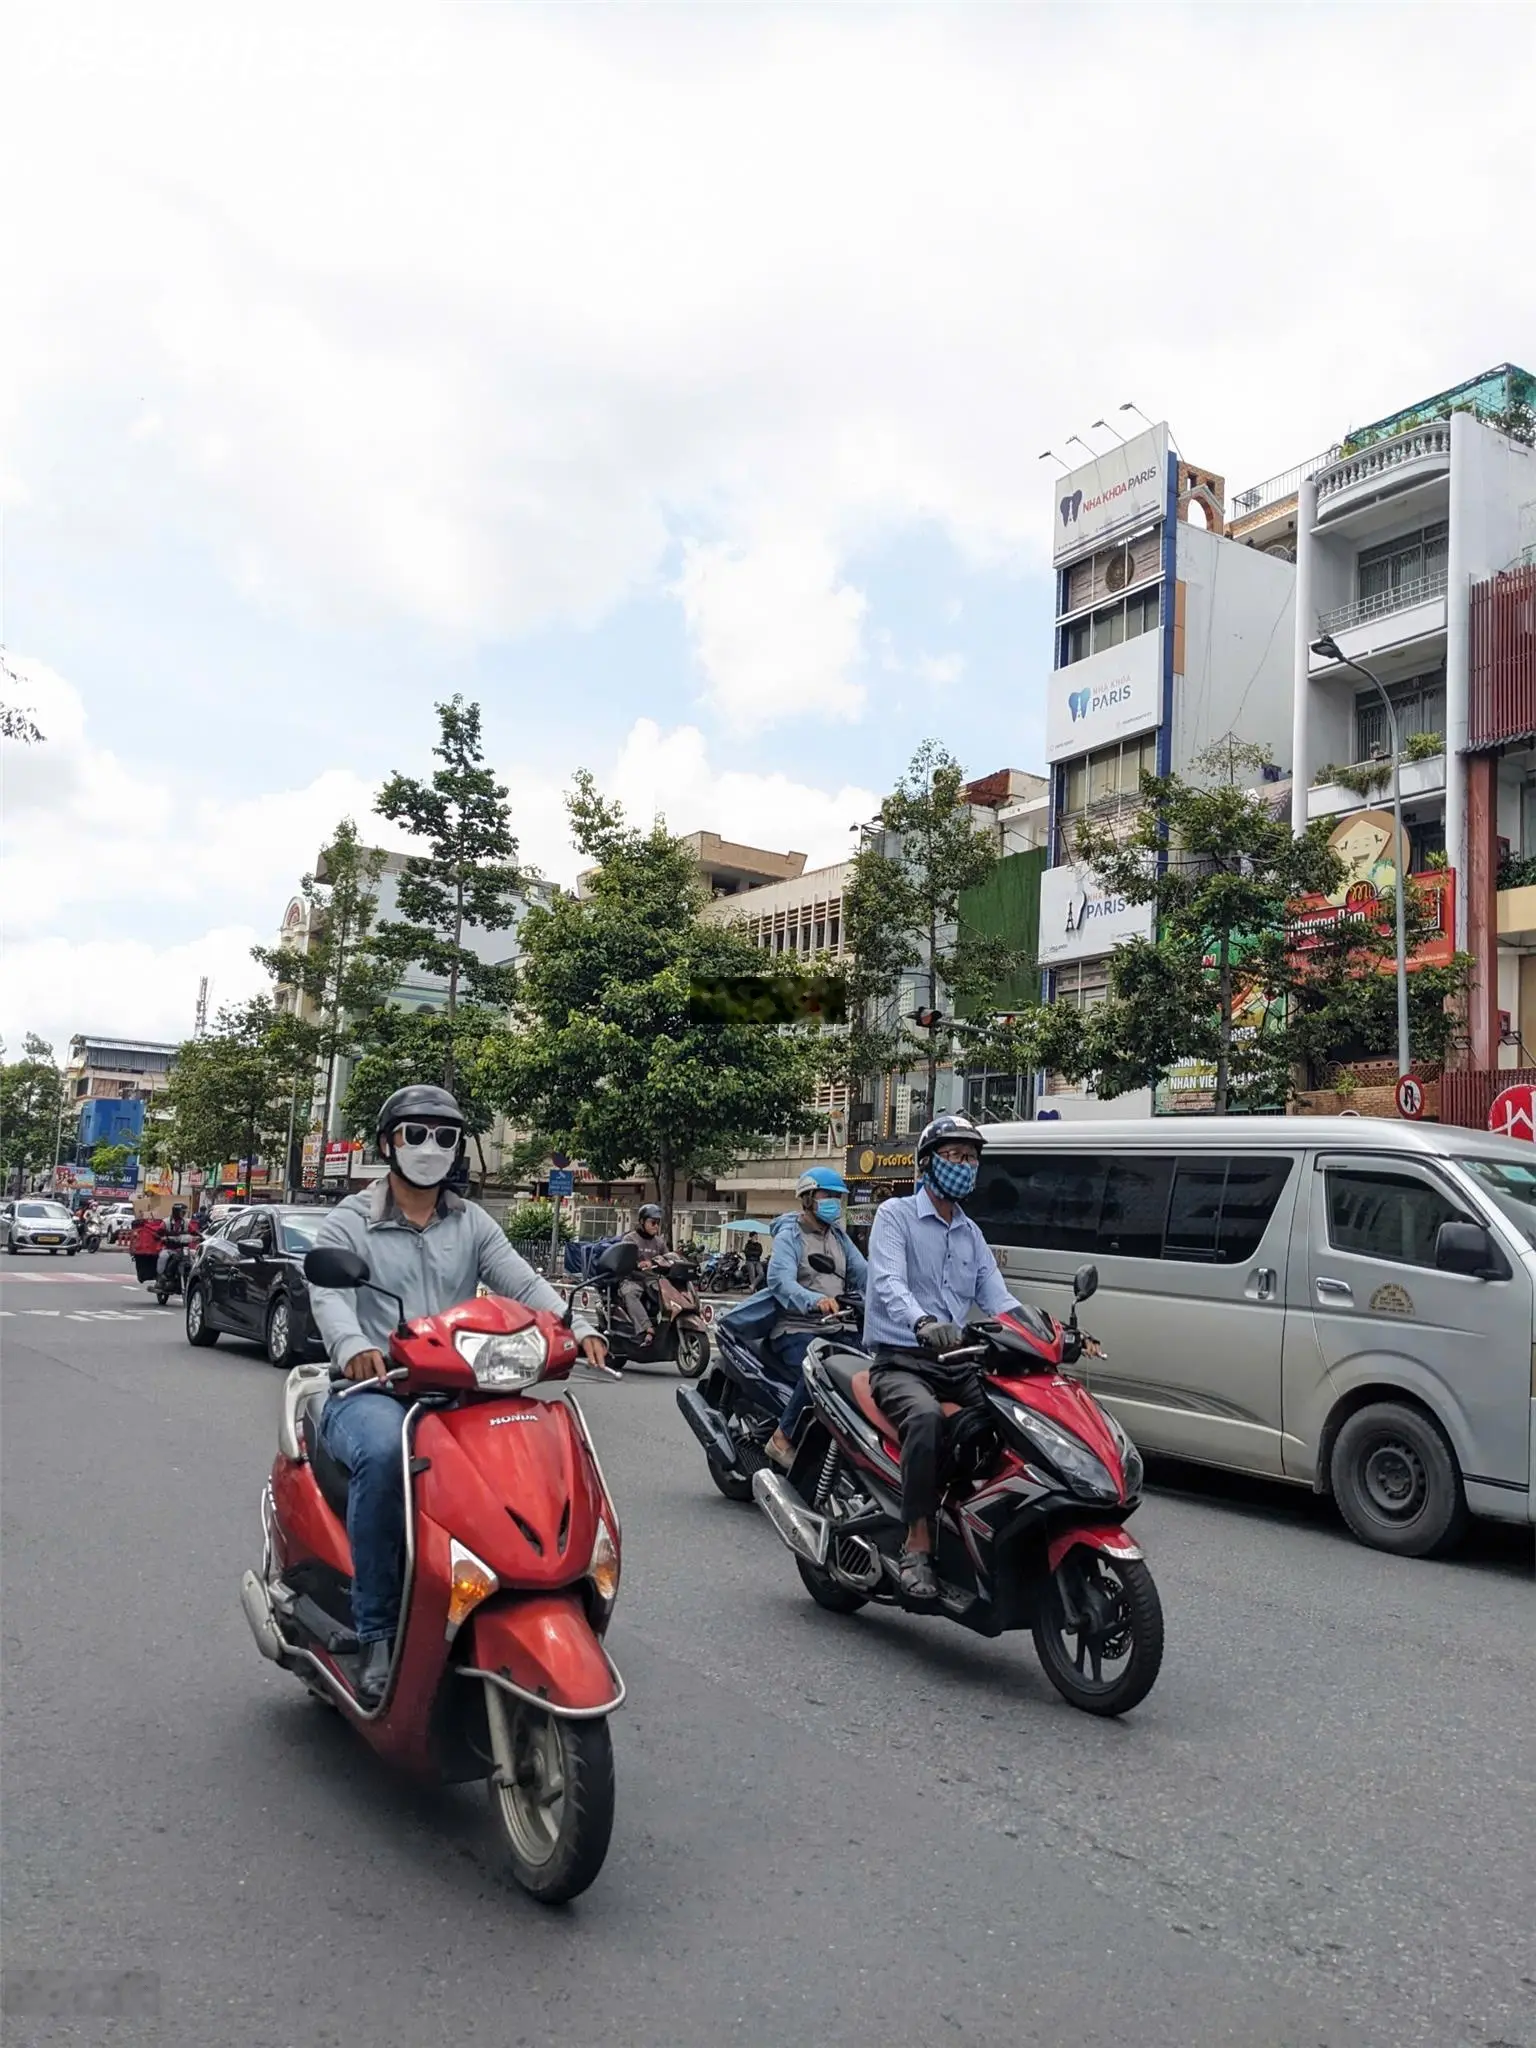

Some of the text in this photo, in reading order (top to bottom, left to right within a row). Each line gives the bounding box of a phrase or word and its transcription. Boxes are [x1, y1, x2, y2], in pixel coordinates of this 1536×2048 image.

[1083, 466, 1157, 514] NHA KHOA PARIS
[1092, 684, 1132, 712] PARIS
[1086, 897, 1126, 919] PARIS
[489, 1413, 539, 1427] HONDA
